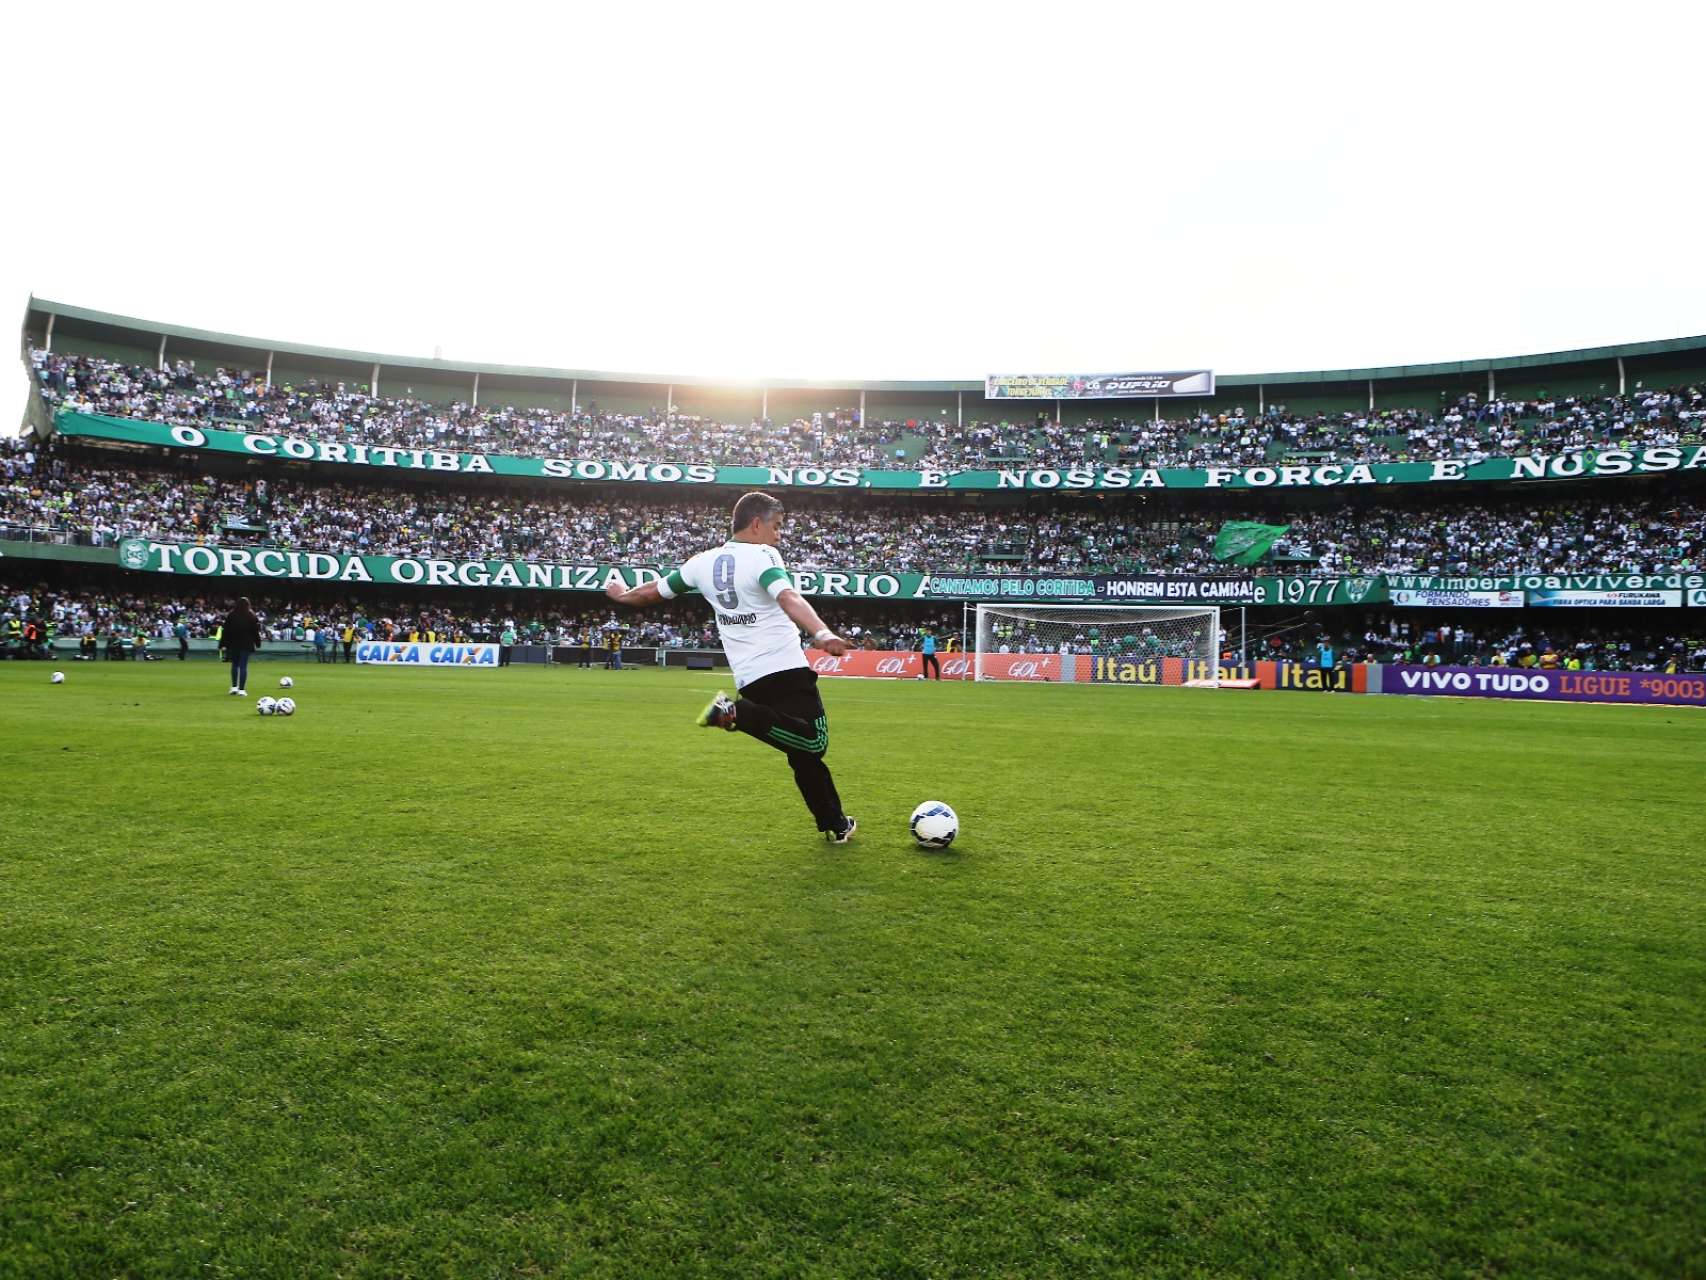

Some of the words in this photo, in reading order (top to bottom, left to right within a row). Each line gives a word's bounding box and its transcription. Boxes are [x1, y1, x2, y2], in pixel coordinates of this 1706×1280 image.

[170, 426, 206, 447] O
[242, 434, 494, 473] CORITIBA
[541, 459, 717, 483] SOMOS
[996, 470, 1165, 489] NOSSA
[148, 543, 373, 582] TORCIDA
[390, 559, 662, 590] ORGANIZAD
[713, 555, 738, 609] 9
[930, 577, 999, 594] CANTAMOS
[1000, 579, 1035, 595] PELO
[1036, 579, 1096, 596] CORITIBA
[1106, 580, 1164, 597] HONREM
[1166, 582, 1197, 598] ESTA
[1199, 580, 1256, 597] CAMISA!
[1276, 578, 1340, 604] 1977
[1415, 591, 1470, 599] FORMANDO
[1426, 599, 1491, 607] PENSADORES
[358, 645, 419, 662] CAIXA
[430, 647, 494, 664] CAIXA
[1096, 657, 1157, 683] Itaú
[1401, 671, 1471, 689] VIVO
[1475, 674, 1549, 692] TUDO
[1560, 676, 1631, 695] LIGUE
